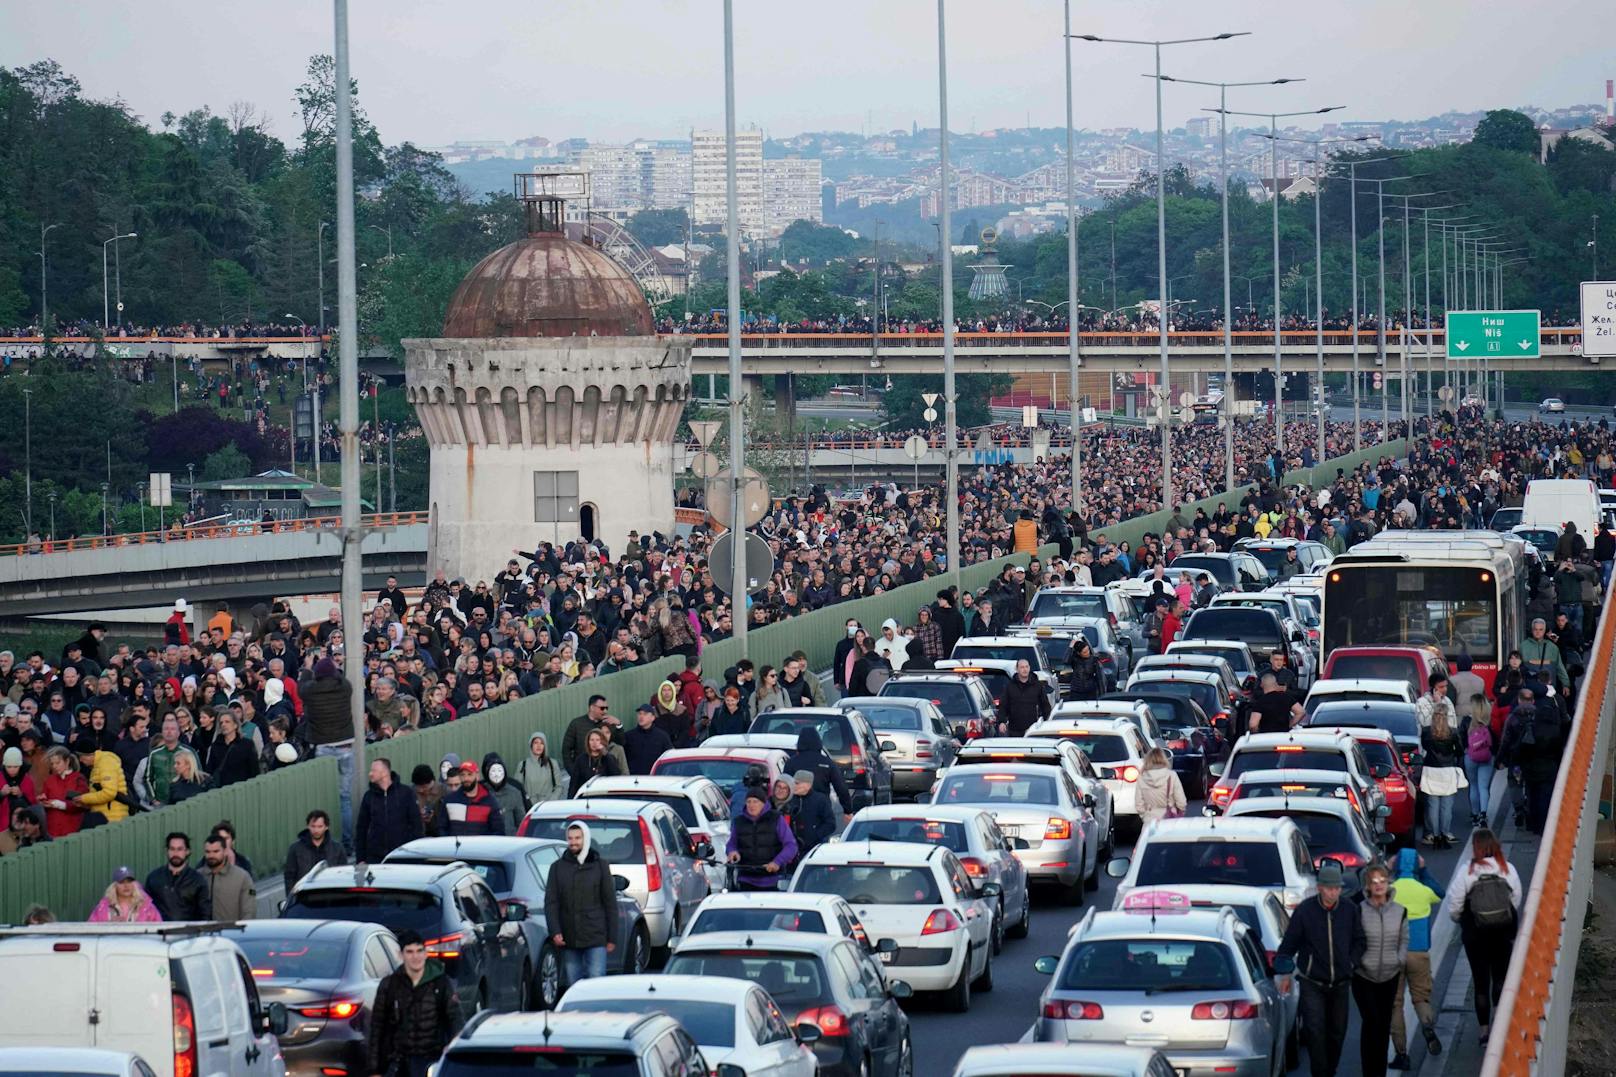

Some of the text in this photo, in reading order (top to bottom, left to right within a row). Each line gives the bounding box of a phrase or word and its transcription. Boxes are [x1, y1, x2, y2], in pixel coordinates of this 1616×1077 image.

[1482, 317, 1504, 326] Ниш
[1591, 315, 1615, 324] Жел.
[1485, 328, 1502, 337] Niš
